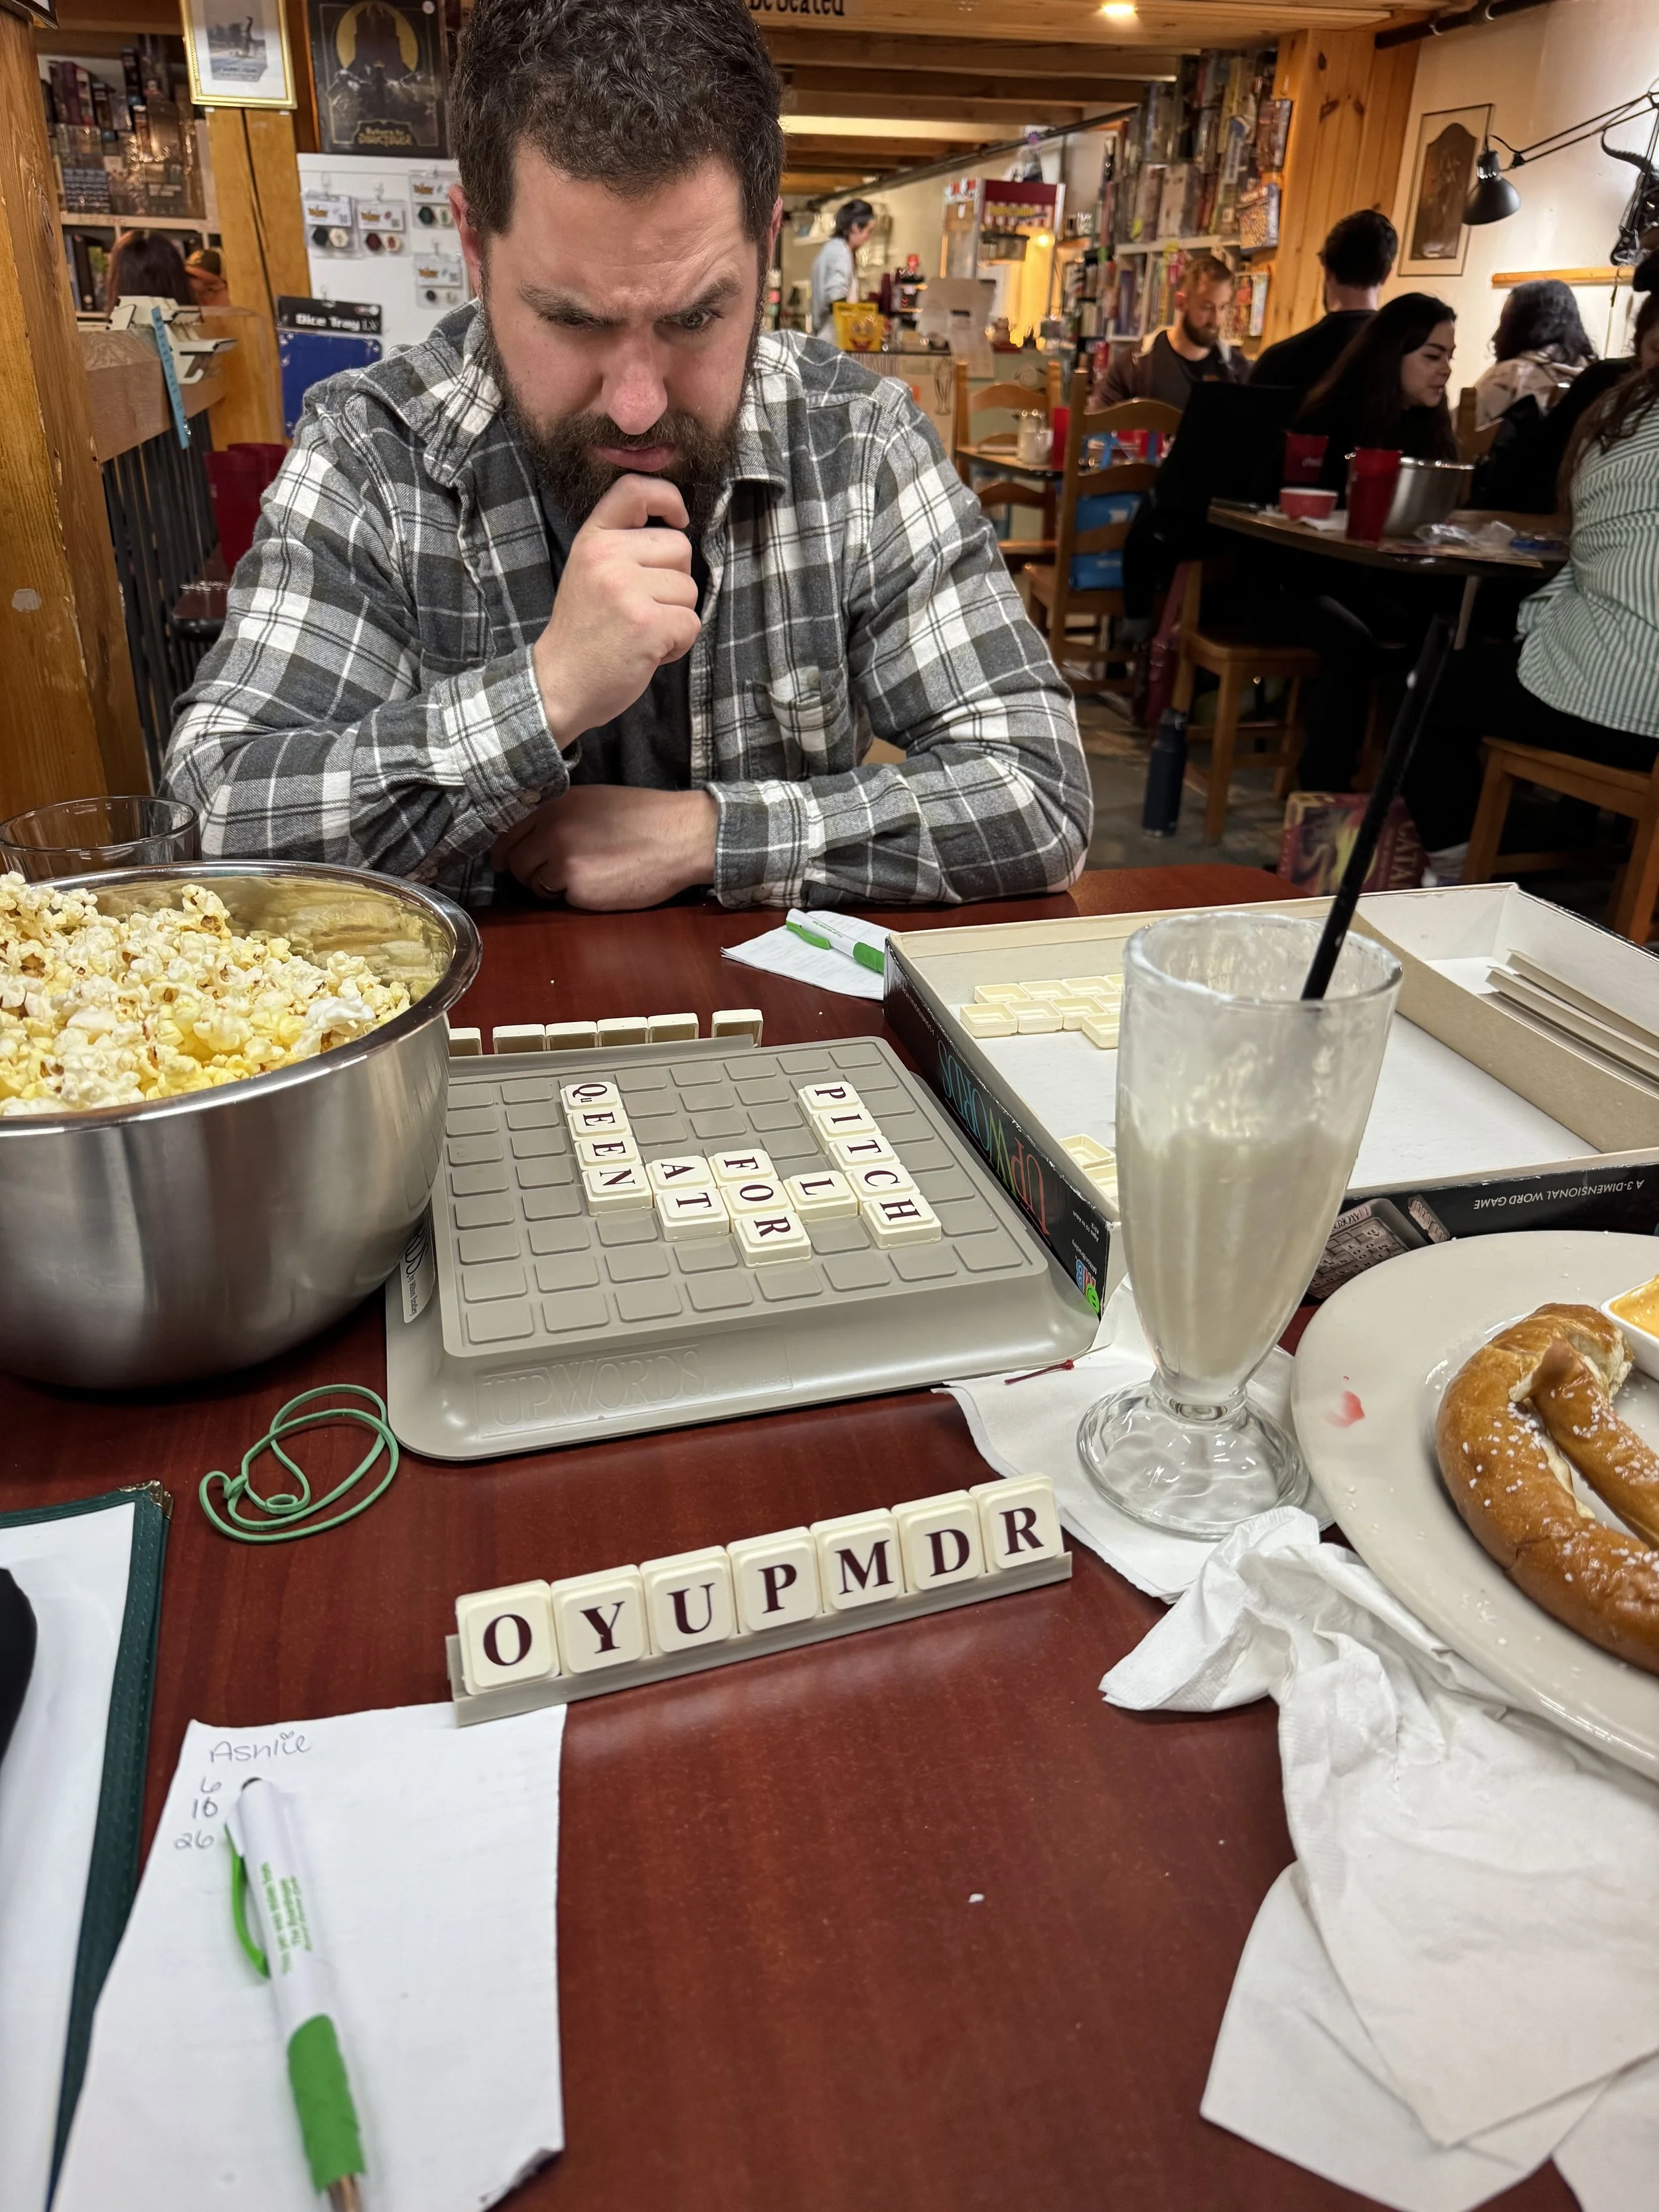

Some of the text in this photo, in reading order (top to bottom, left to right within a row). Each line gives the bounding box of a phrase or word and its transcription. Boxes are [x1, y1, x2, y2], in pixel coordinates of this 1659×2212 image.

[295, 313, 326, 327] Dice
[328, 316, 360, 331] Tray
[814, 1086, 921, 1222] PITCH
[938, 1039, 1050, 1235] UPWORDS
[1473, 1179, 1644, 1210] A 3-DIMENSIONAL WORD GAME
[482, 1350, 708, 1428] UPWORDS
